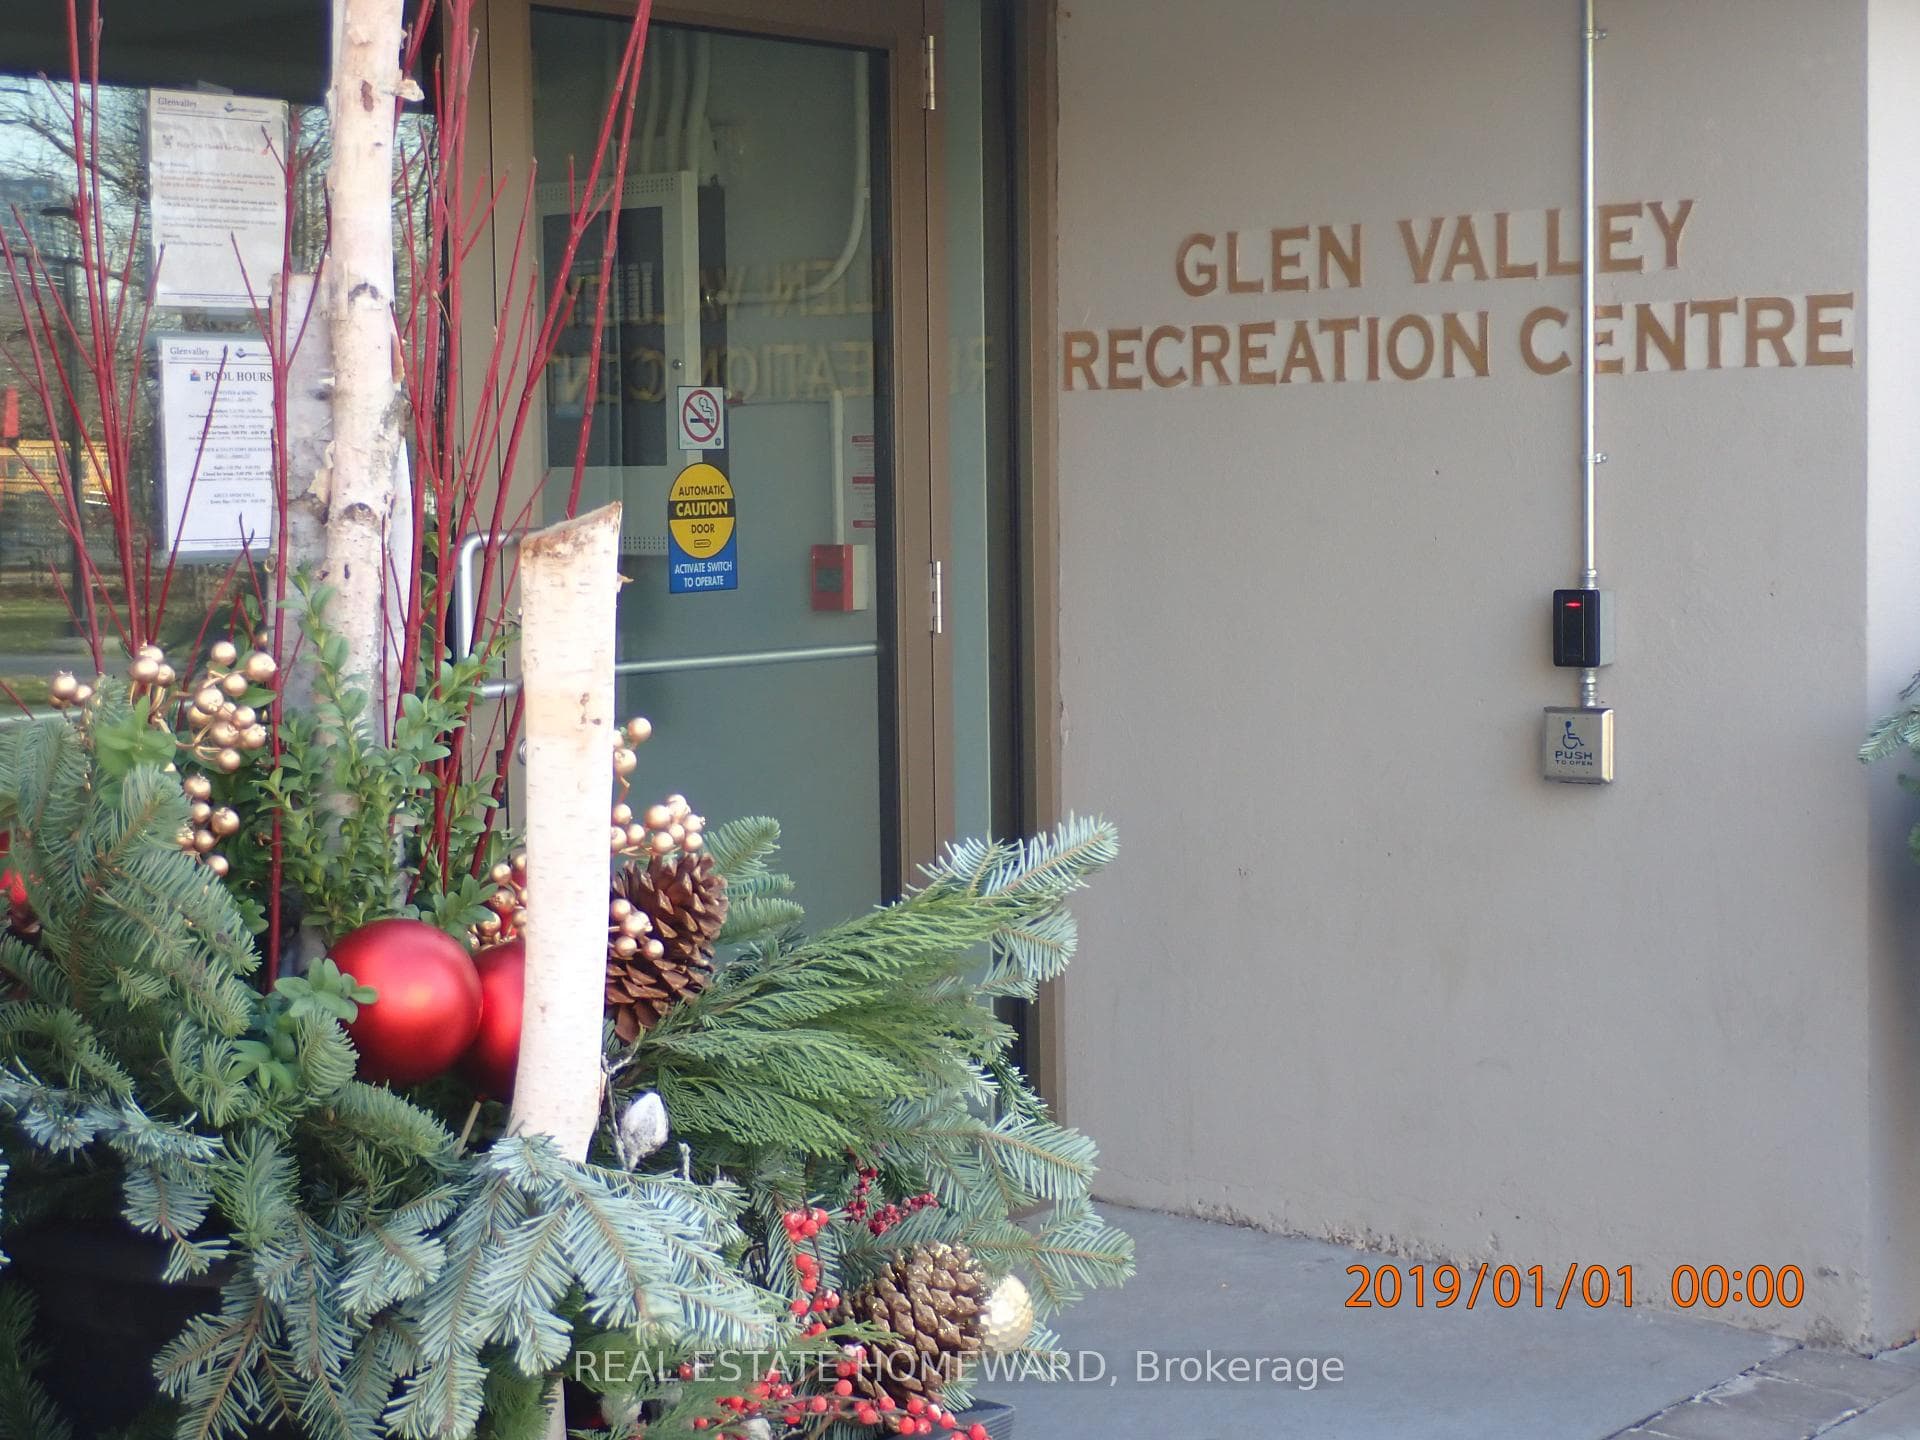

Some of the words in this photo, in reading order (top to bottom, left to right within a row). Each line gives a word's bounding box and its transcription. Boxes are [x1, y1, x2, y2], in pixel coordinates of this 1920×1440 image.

[1175, 222, 1363, 297] GLEN
[1398, 199, 1695, 284] VALLEY
[1062, 311, 1490, 392] RECREATION
[1519, 291, 1856, 376] CENTRE
[169, 345, 210, 359] Glenvalley
[205, 371, 235, 382] POOL
[236, 371, 272, 382] HOURS
[679, 485, 725, 496] AUTOMATIC
[676, 501, 728, 517] CAUTION
[691, 523, 715, 534] DOOR
[675, 563, 705, 574] ACTIVATE
[708, 561, 732, 571] SWITCH
[684, 577, 693, 588] TO
[695, 575, 724, 587] OPERATE
[1555, 751, 1592, 760] PUSH
